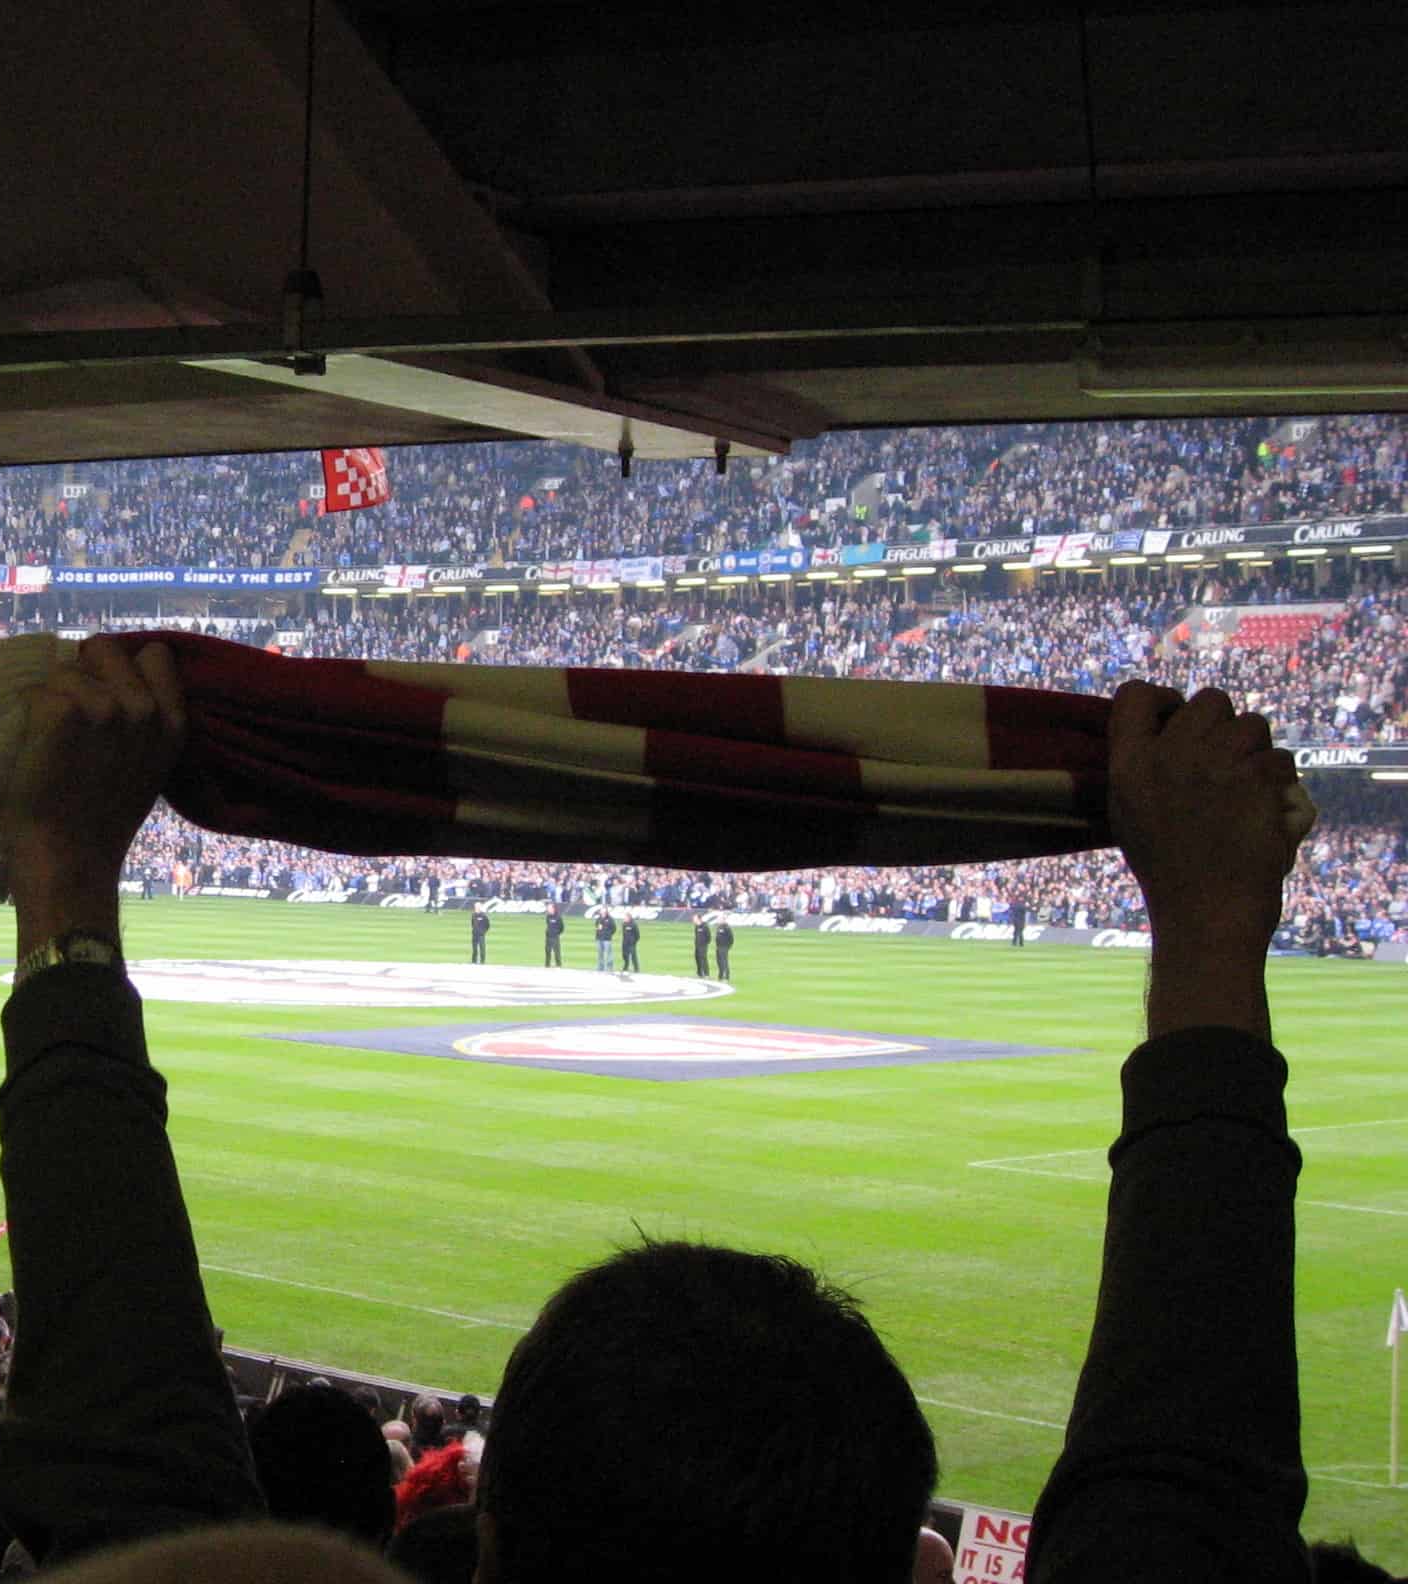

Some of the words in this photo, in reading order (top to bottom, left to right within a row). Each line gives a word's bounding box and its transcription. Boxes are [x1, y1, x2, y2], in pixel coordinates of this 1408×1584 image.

[1181, 528, 1245, 548] CARLING
[1294, 523, 1362, 543] CARLING
[973, 539, 1030, 558] CARLING
[56, 571, 92, 583] JOSE
[96, 571, 175, 584] MOURINHO
[183, 570, 234, 584] SIMPLY
[240, 572, 268, 583] THE
[274, 571, 313, 583] BEST
[327, 568, 385, 584] CARLING
[428, 567, 484, 583] CARLING
[1295, 748, 1368, 766] CARLING
[960, 1548, 979, 1570] IT
[985, 1553, 1003, 1576] IS
